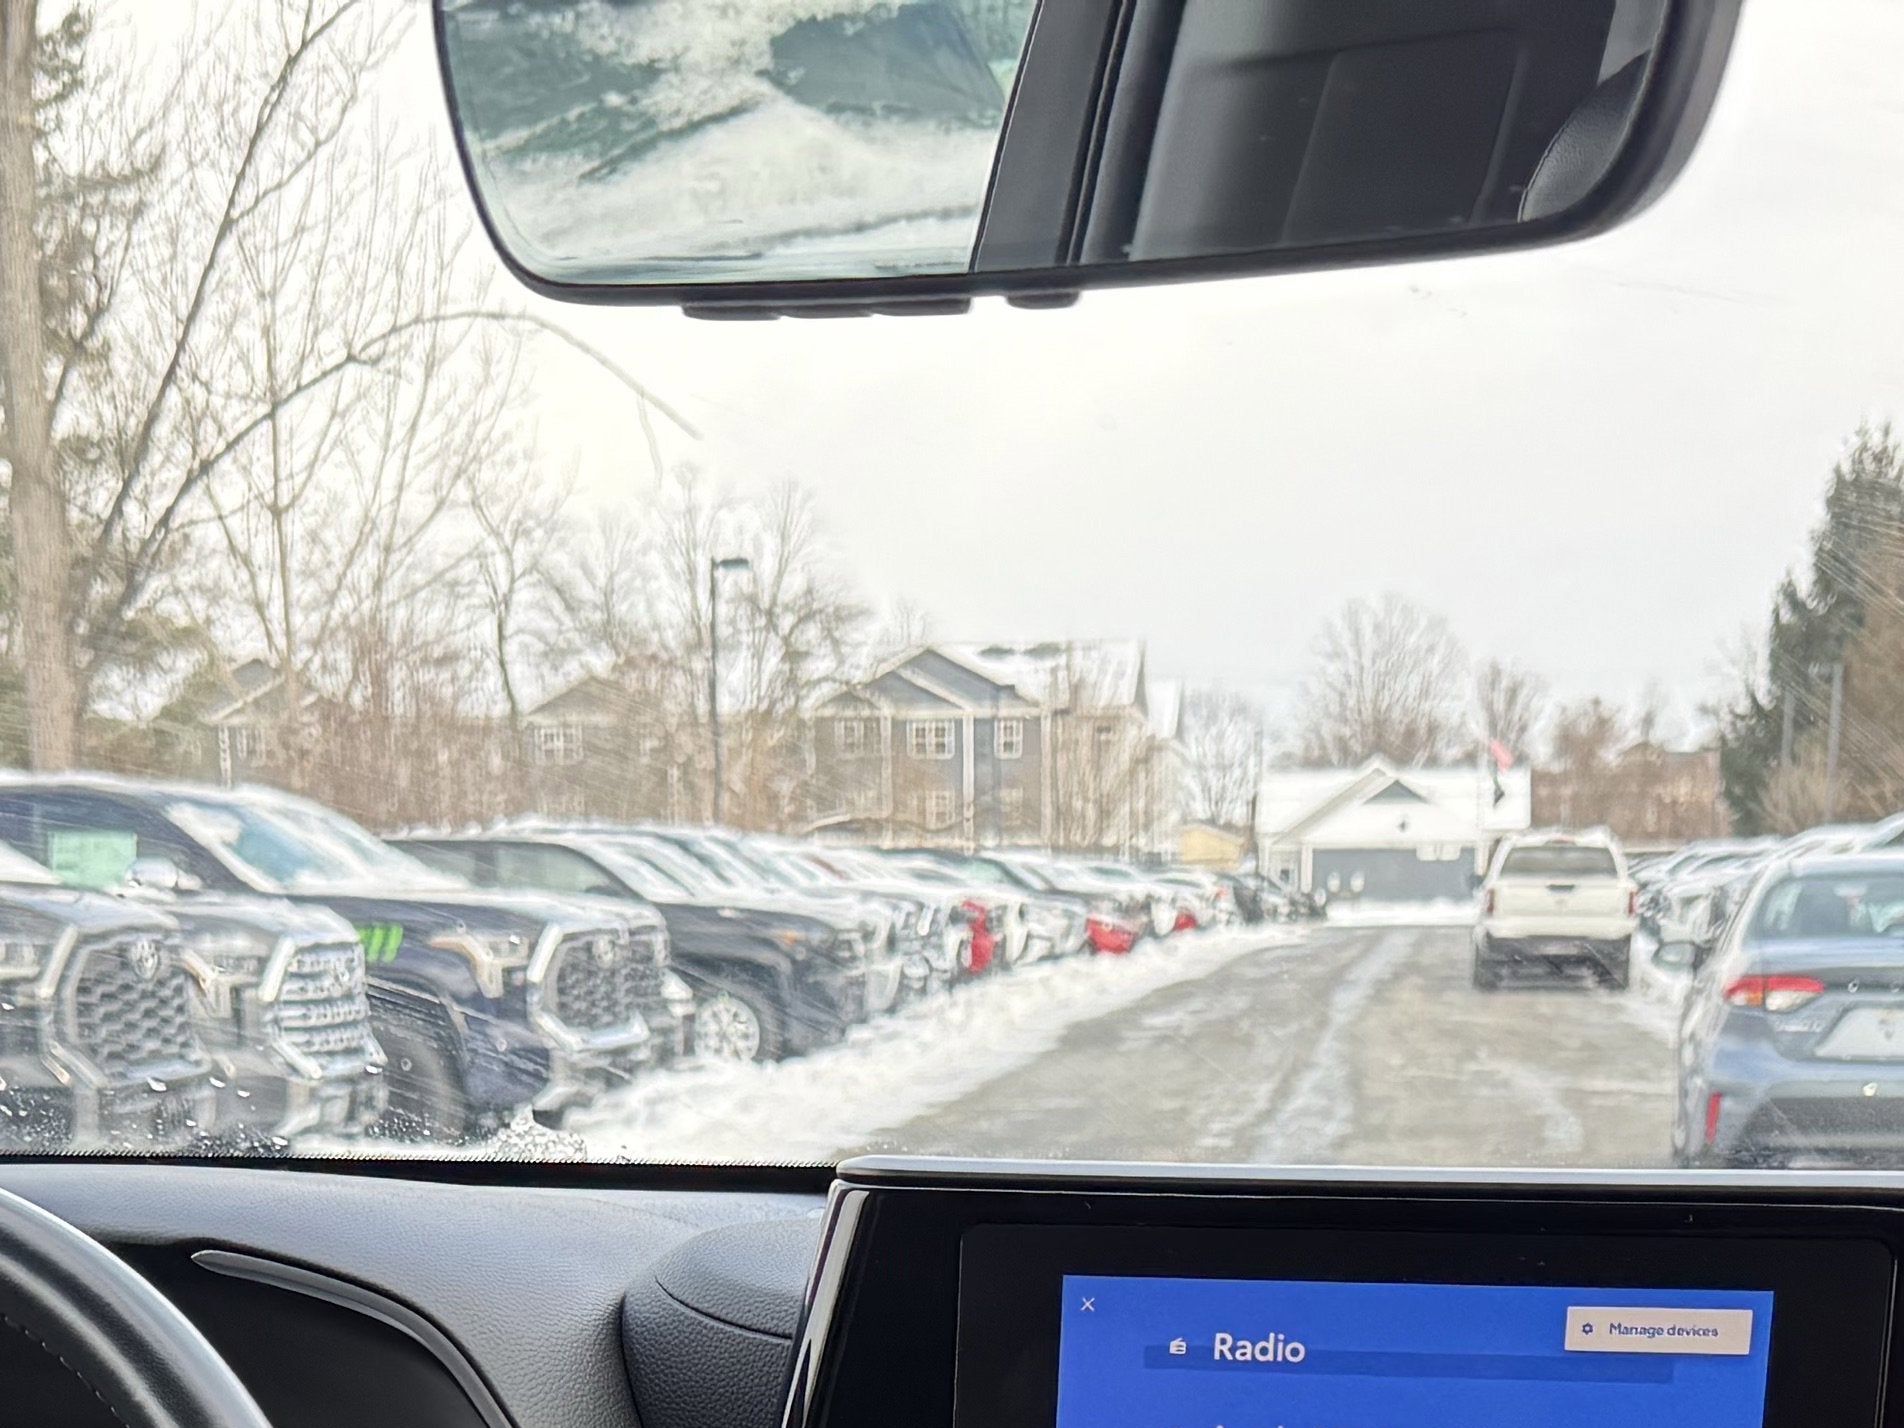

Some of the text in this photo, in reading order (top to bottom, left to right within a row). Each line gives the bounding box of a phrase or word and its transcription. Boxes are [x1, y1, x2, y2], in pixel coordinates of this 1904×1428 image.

[1609, 1322, 1719, 1338] Manage devices
[1213, 1333, 1306, 1364] Radio
